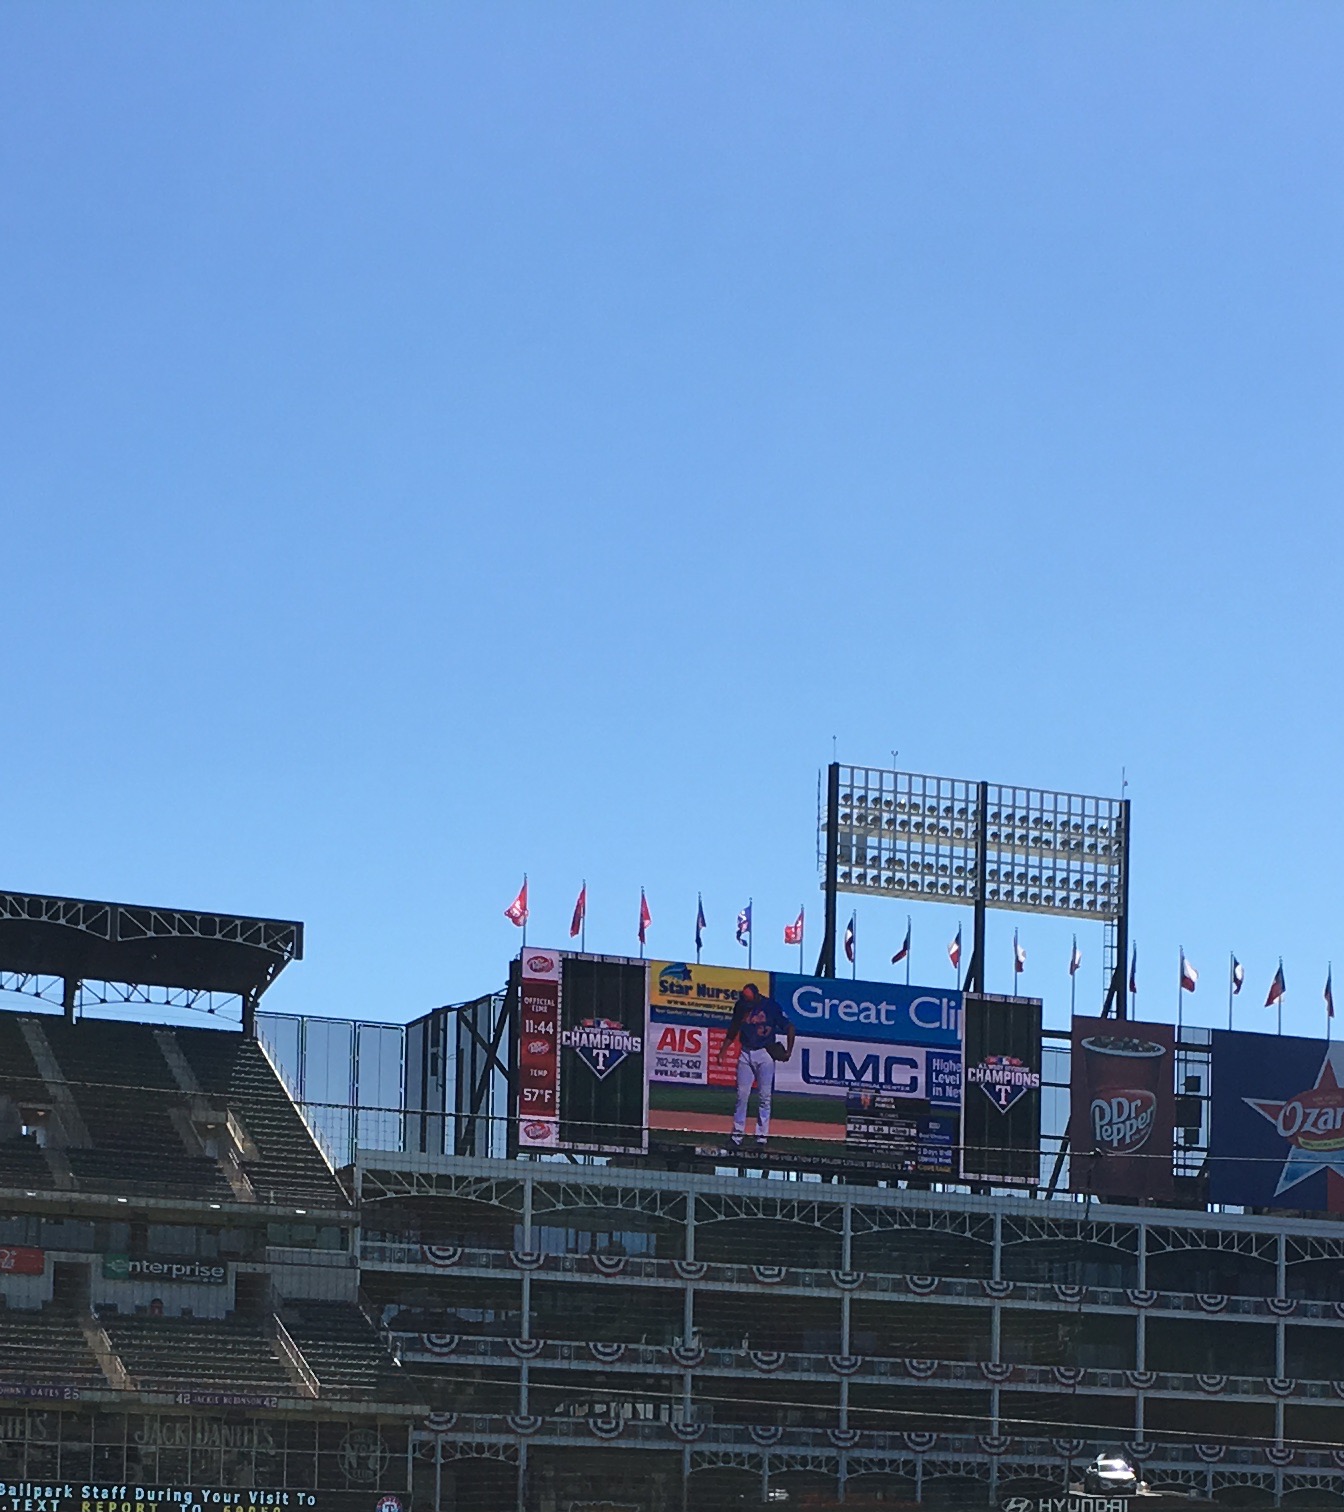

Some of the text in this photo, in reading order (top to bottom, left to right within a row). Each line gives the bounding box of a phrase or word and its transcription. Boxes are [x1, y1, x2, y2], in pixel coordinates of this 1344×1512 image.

[659, 980, 693, 995] Star
[524, 996, 555, 1006] OFFICIAL
[792, 986, 896, 1025] Great
[525, 1020, 554, 1035] 11:44
[562, 1030, 642, 1052] CHAMPIONS
[657, 1028, 702, 1053] AIS
[592, 1049, 610, 1070] T
[530, 1069, 548, 1077] TEMP
[802, 1048, 918, 1093] UMC
[967, 1067, 1039, 1087] CHAMPIONS
[523, 1088, 553, 1103] 57°F
[933, 1084, 942, 1096] in
[995, 1085, 1011, 1104] T
[1111, 1097, 1141, 1123] Dr
[1090, 1099, 1154, 1147] Pepper
[108, 1256, 225, 1279] enterprise
[176, 1393, 190, 1404] 42
[193, 1395, 219, 1404] JACKIE
[264, 1397, 278, 1408] 42
[134, 1415, 190, 1446] JACK
[81, 1485, 127, 1500] Staff
[135, 1487, 193, 1504] During
[201, 1489, 241, 1505] Your
[249, 1490, 289, 1505] Visit
[297, 1492, 316, 1506] To
